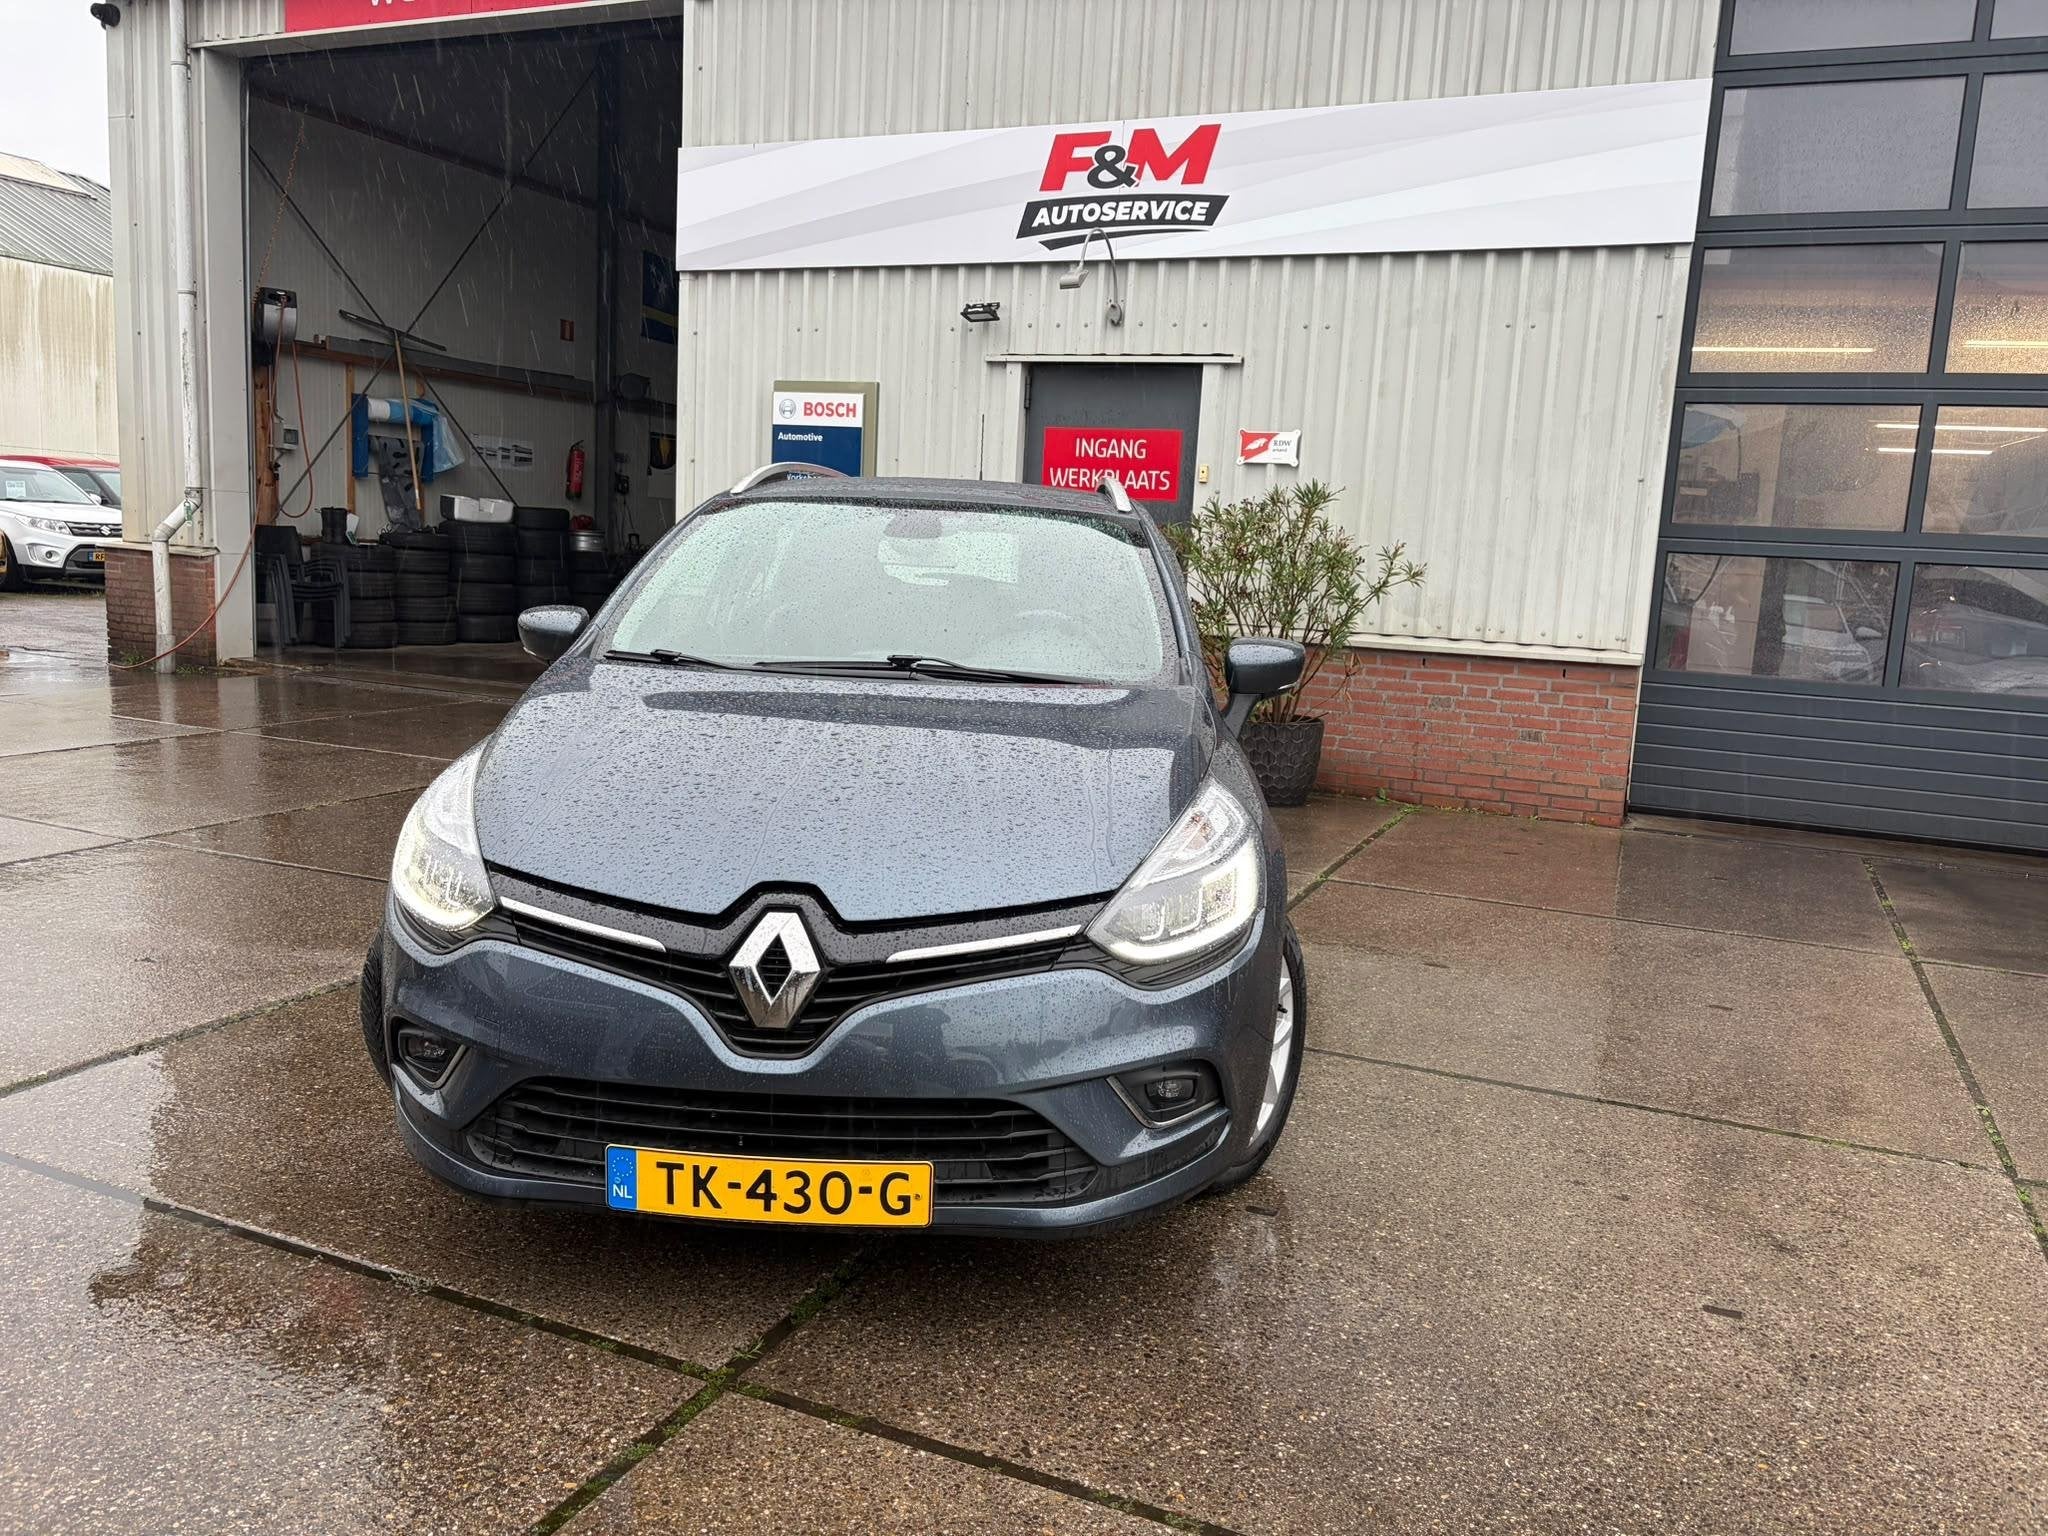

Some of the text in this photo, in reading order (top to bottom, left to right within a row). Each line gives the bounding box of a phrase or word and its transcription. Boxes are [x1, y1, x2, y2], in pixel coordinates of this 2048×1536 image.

[1039, 124, 1222, 191] F&M
[1032, 200, 1210, 228] AUTOSERVICE
[803, 401, 857, 418] BOSCH
[777, 431, 824, 442] Automotive
[1273, 439, 1292, 447] RDW
[1075, 437, 1148, 460] INGANG
[612, 1184, 633, 1199] NL
[655, 1161, 912, 1216] TK-430-G
